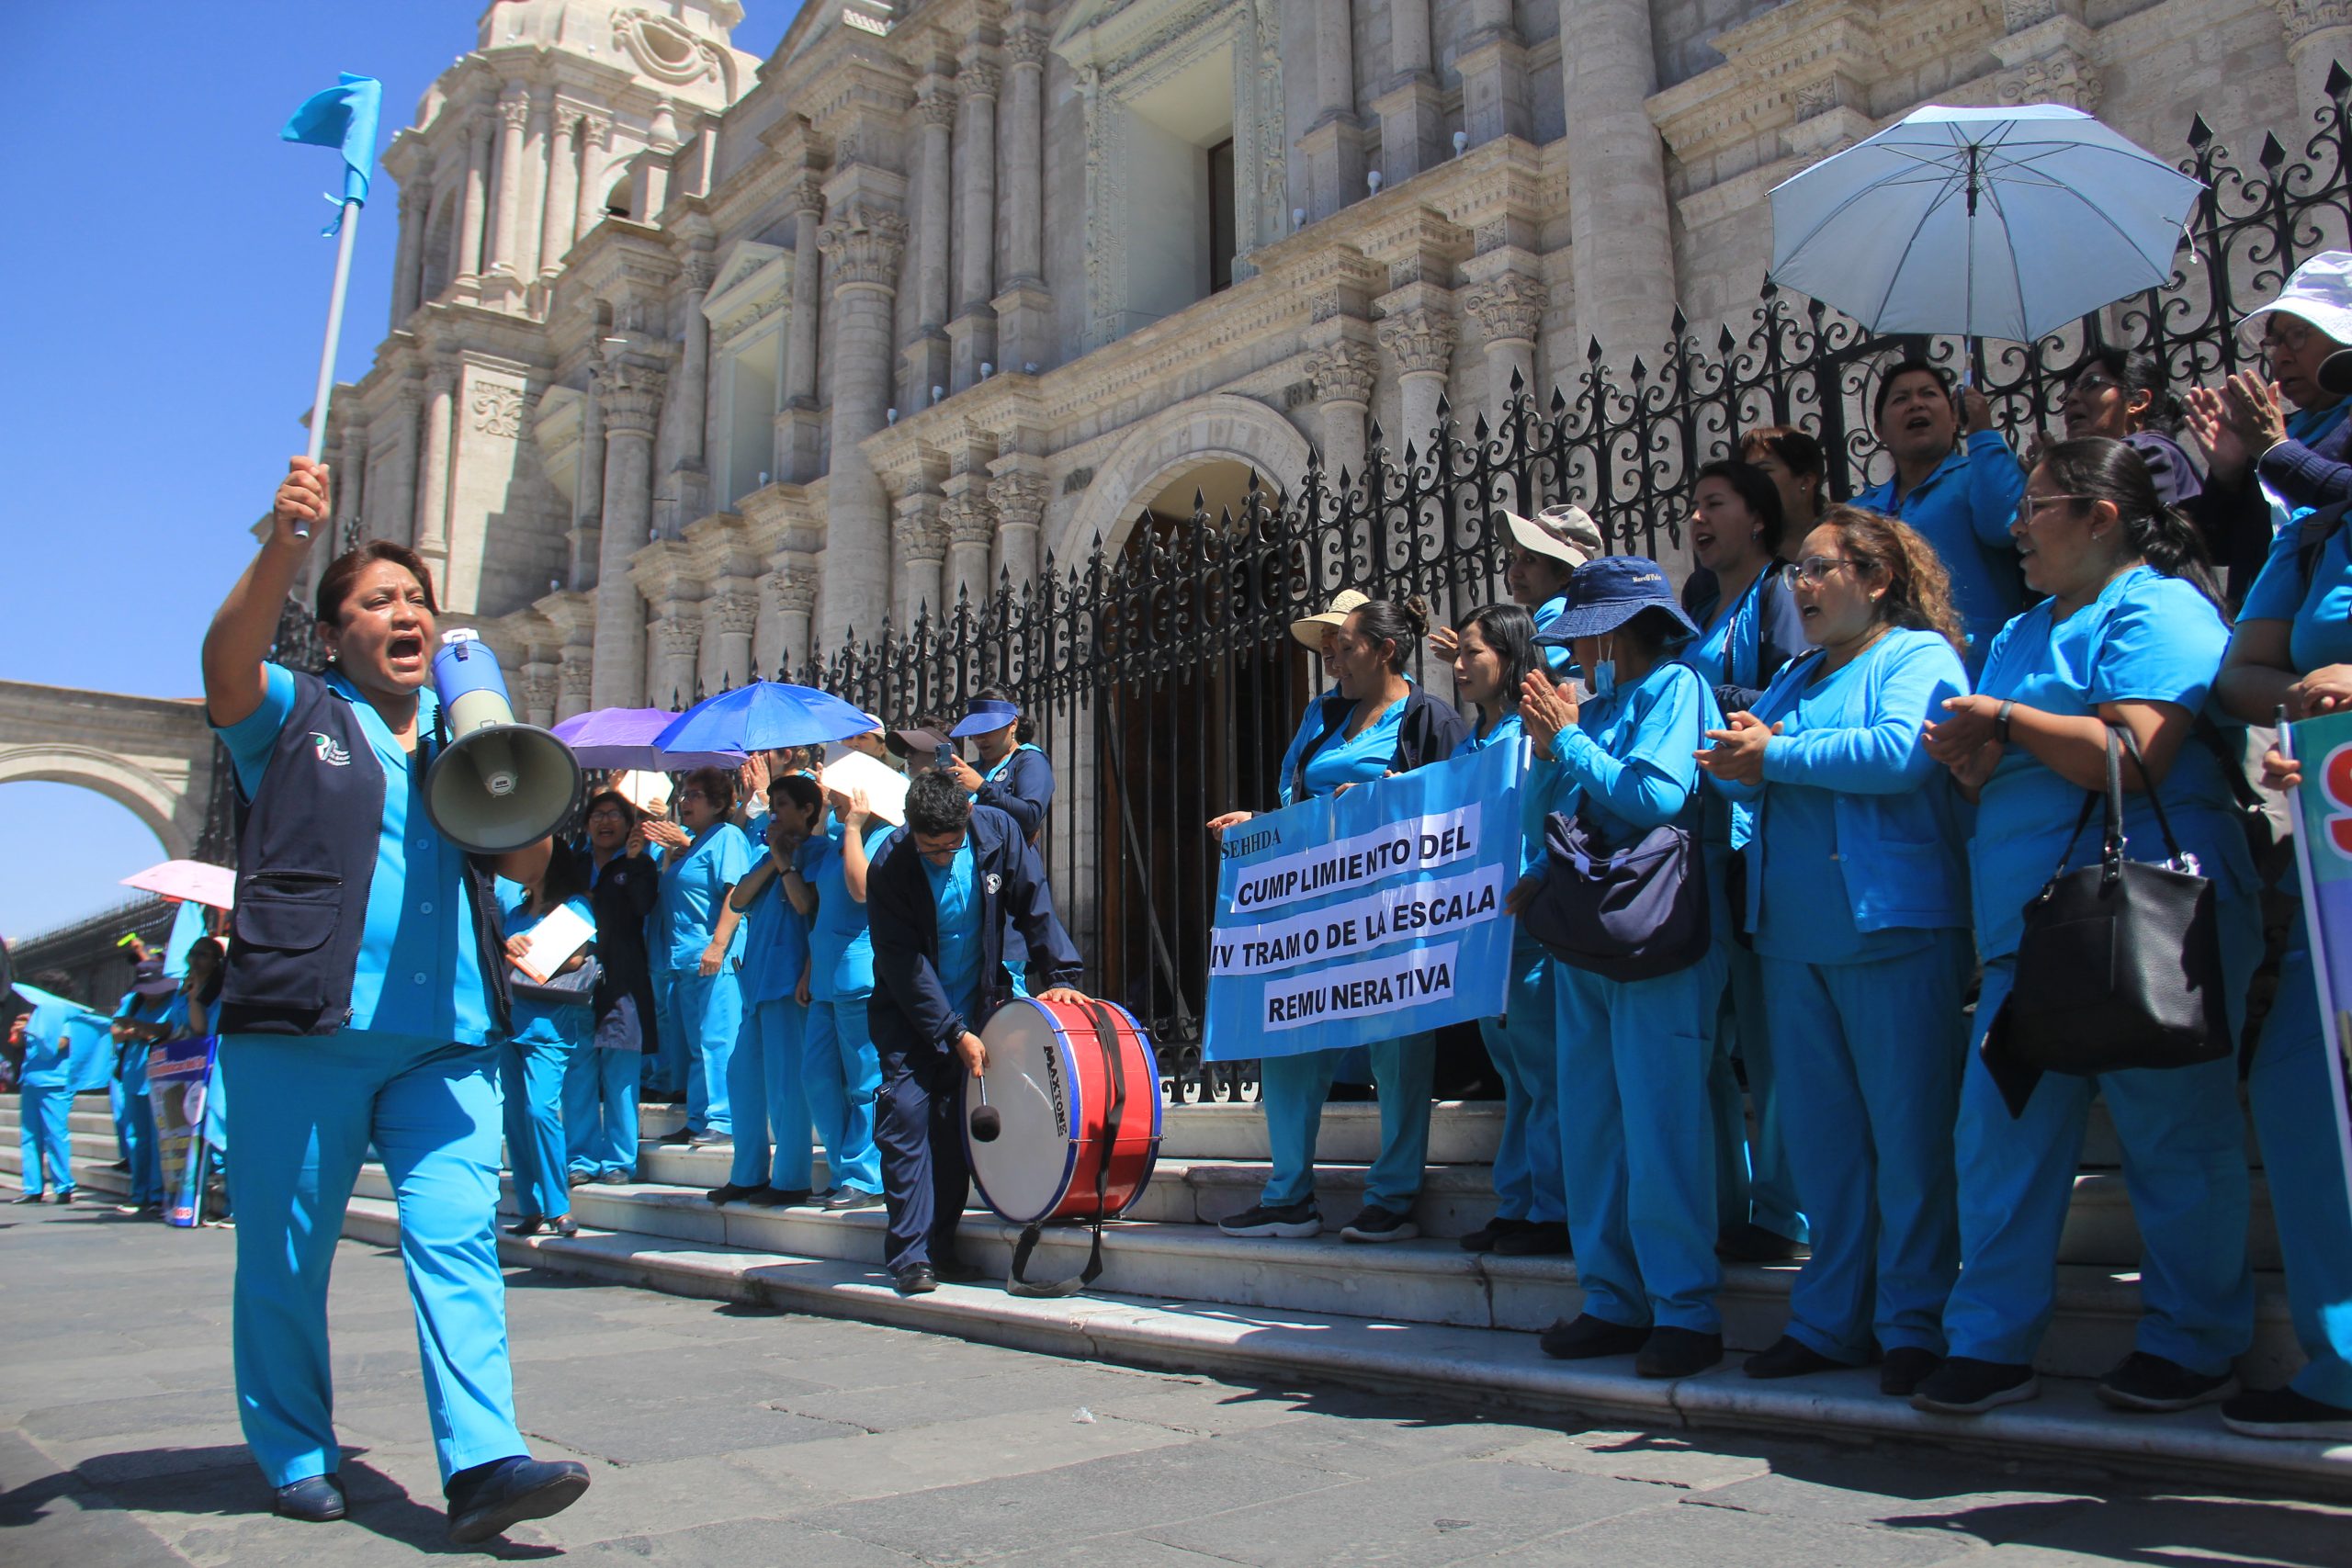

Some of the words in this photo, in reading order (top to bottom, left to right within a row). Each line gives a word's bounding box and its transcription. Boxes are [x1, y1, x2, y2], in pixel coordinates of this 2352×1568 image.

[1220, 826, 1283, 861] SEHHDA
[1238, 838, 1411, 907] CUMPLIMIENTO
[1418, 825, 1471, 861] DEL
[1211, 944, 1235, 968] IV
[1242, 929, 1319, 967] TRAMO
[1326, 919, 1357, 950] DE
[1365, 910, 1387, 942] LA
[1393, 885, 1496, 932] ESCALA
[1044, 1045, 1069, 1136] MAXTONE
